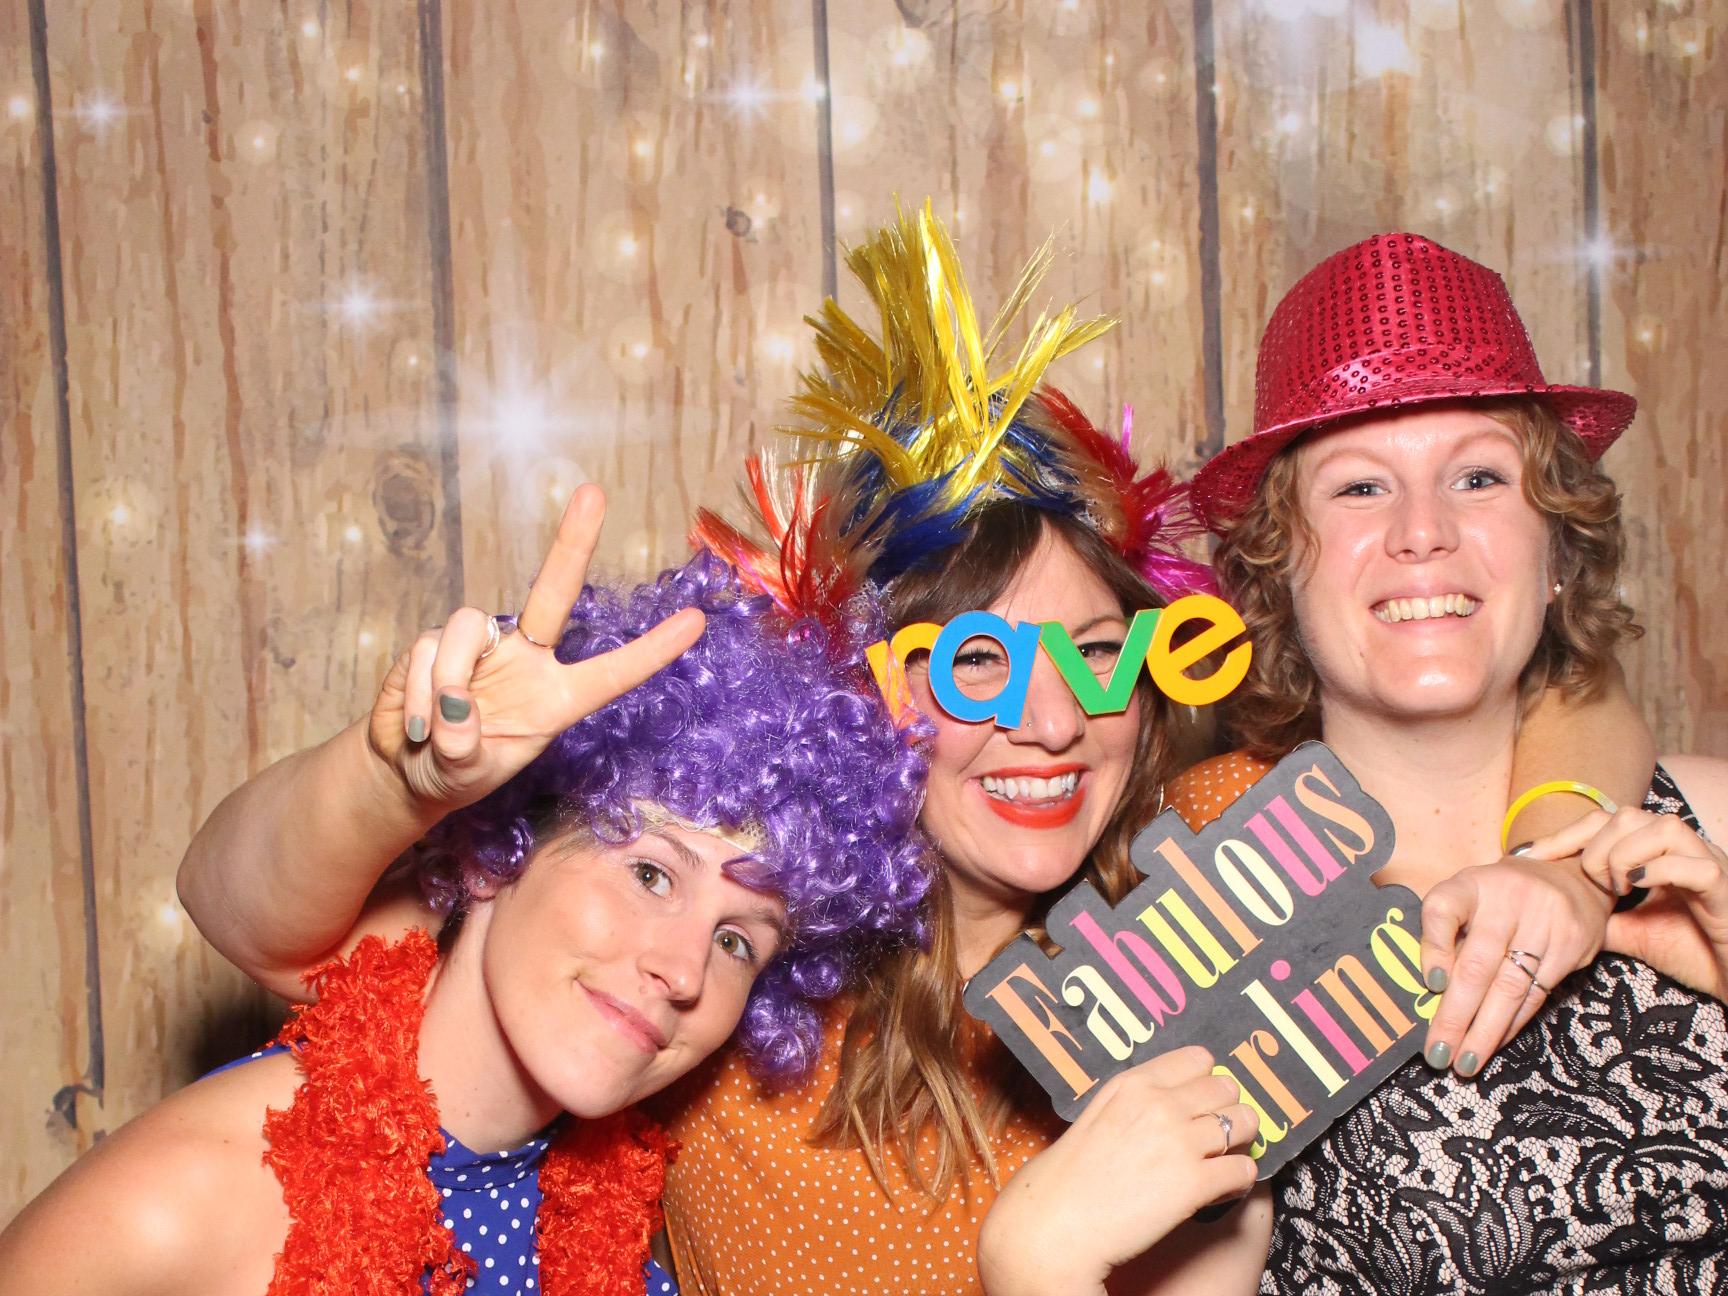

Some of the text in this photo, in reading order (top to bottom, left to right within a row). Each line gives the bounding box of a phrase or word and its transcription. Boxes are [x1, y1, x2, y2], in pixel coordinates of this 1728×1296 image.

[864, 594, 1252, 731] rave
[985, 763, 1375, 1101] Fabulous
[1211, 907, 1442, 1160] arling
